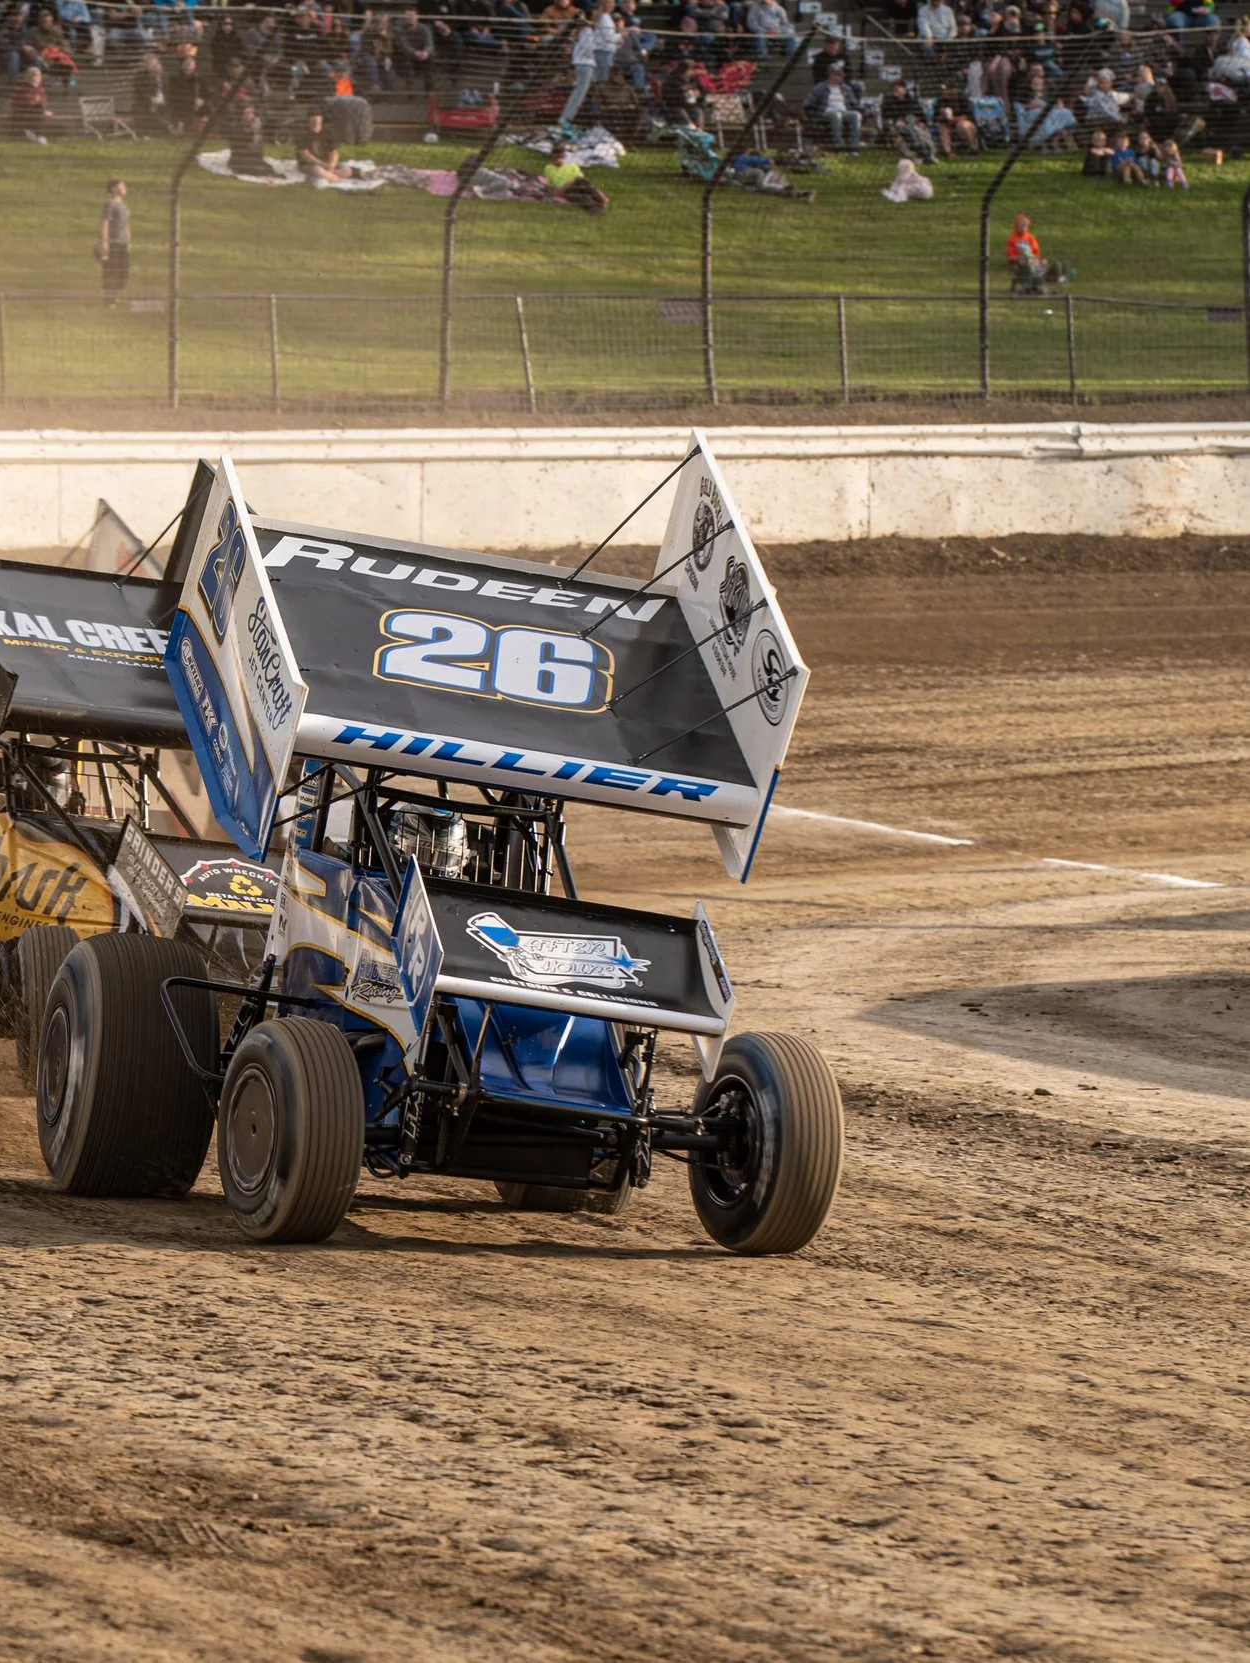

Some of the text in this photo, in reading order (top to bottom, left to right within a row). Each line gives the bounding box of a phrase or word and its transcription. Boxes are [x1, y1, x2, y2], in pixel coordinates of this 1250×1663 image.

[198, 497, 247, 644] 26
[262, 535, 668, 623] RUDEEN
[2, 638, 164, 663] MINING & EXPLOR
[375, 608, 610, 711] 26
[256, 675, 273, 726] CENTER
[332, 724, 719, 803] HILLIER
[124, 823, 183, 907] GRINDER'S
[198, 868, 221, 882] AUTO
[206, 891, 240, 901] METAL
[528, 939, 607, 956] AFTER
[543, 960, 615, 977] HOURS
[352, 982, 403, 1003] Racing
[489, 976, 558, 993] CUSTOMS
[576, 990, 658, 1007] COLLISIONS
